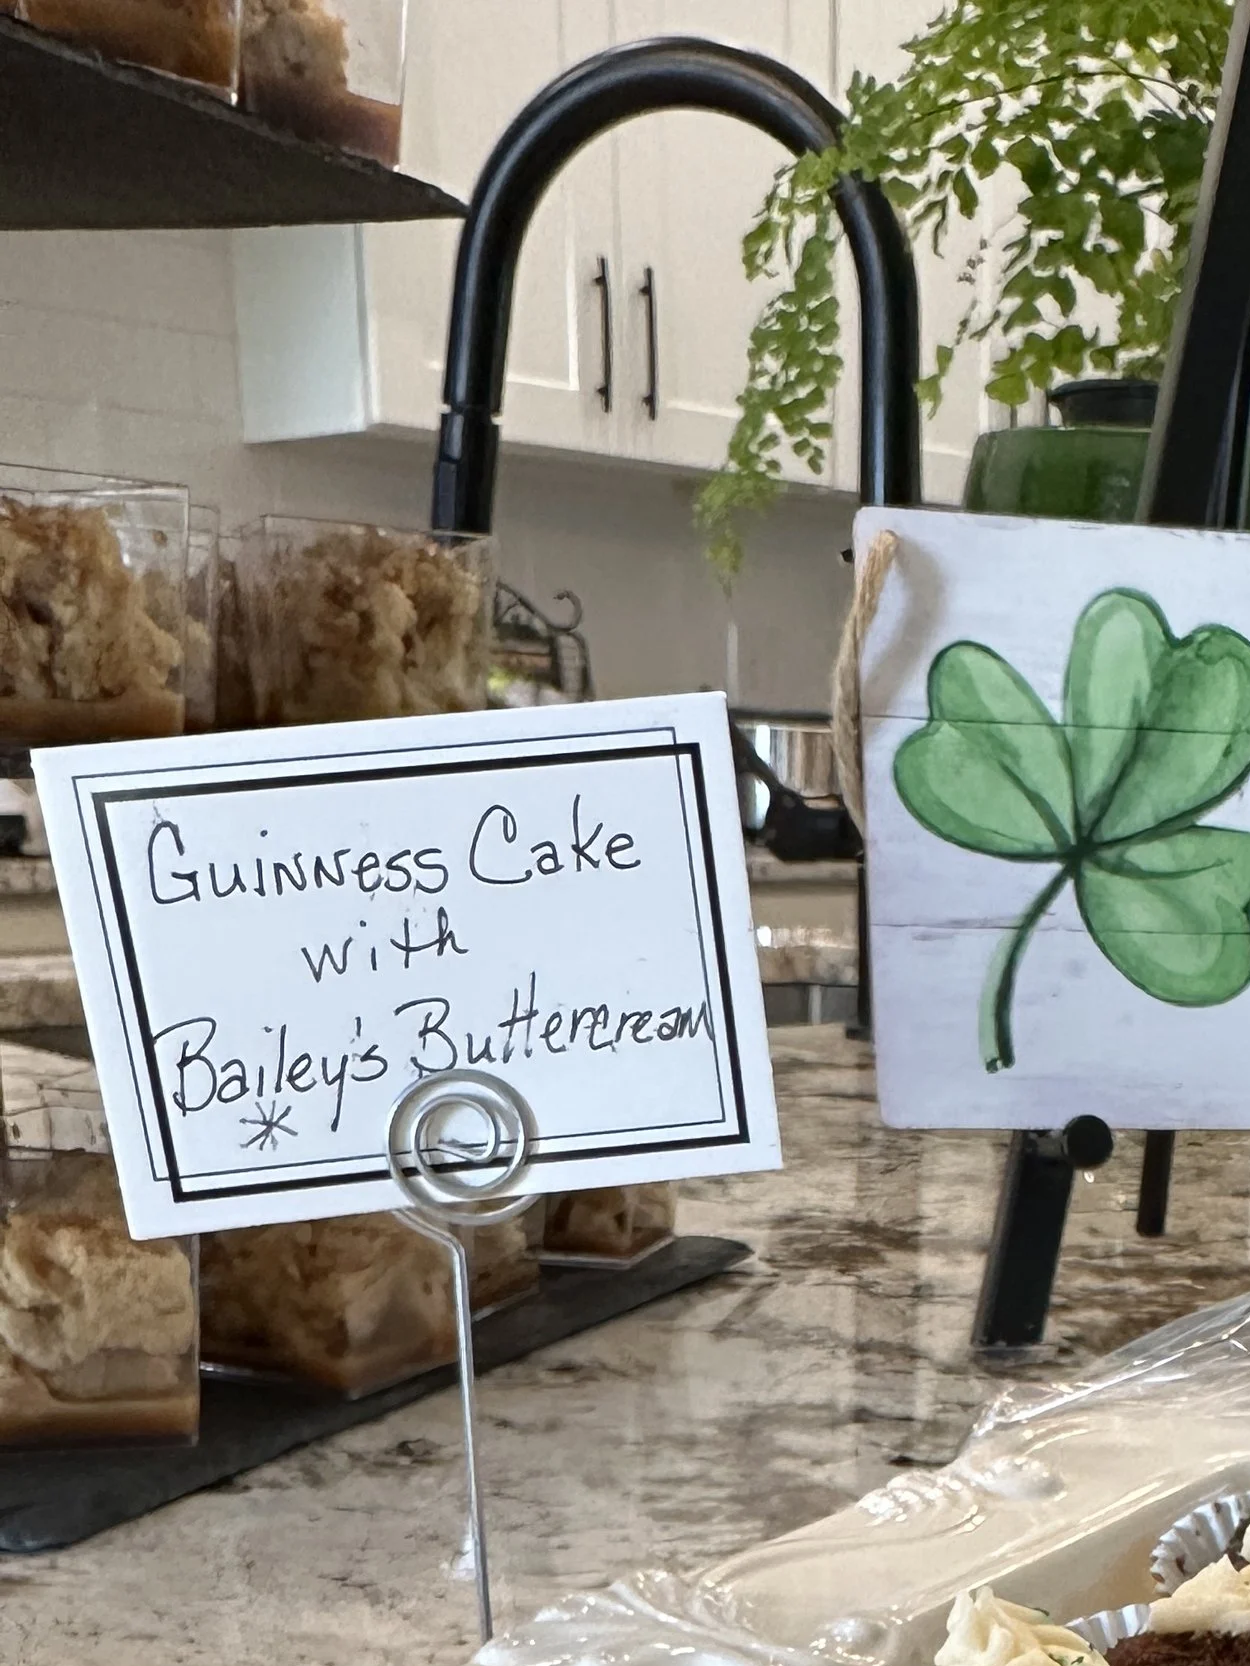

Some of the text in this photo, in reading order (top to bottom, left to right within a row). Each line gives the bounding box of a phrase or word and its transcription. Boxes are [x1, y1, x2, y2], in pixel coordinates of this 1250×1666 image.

[469, 795, 641, 886] Cake
[301, 907, 469, 982] with
[153, 971, 715, 1132] Bailey's Buttercream
